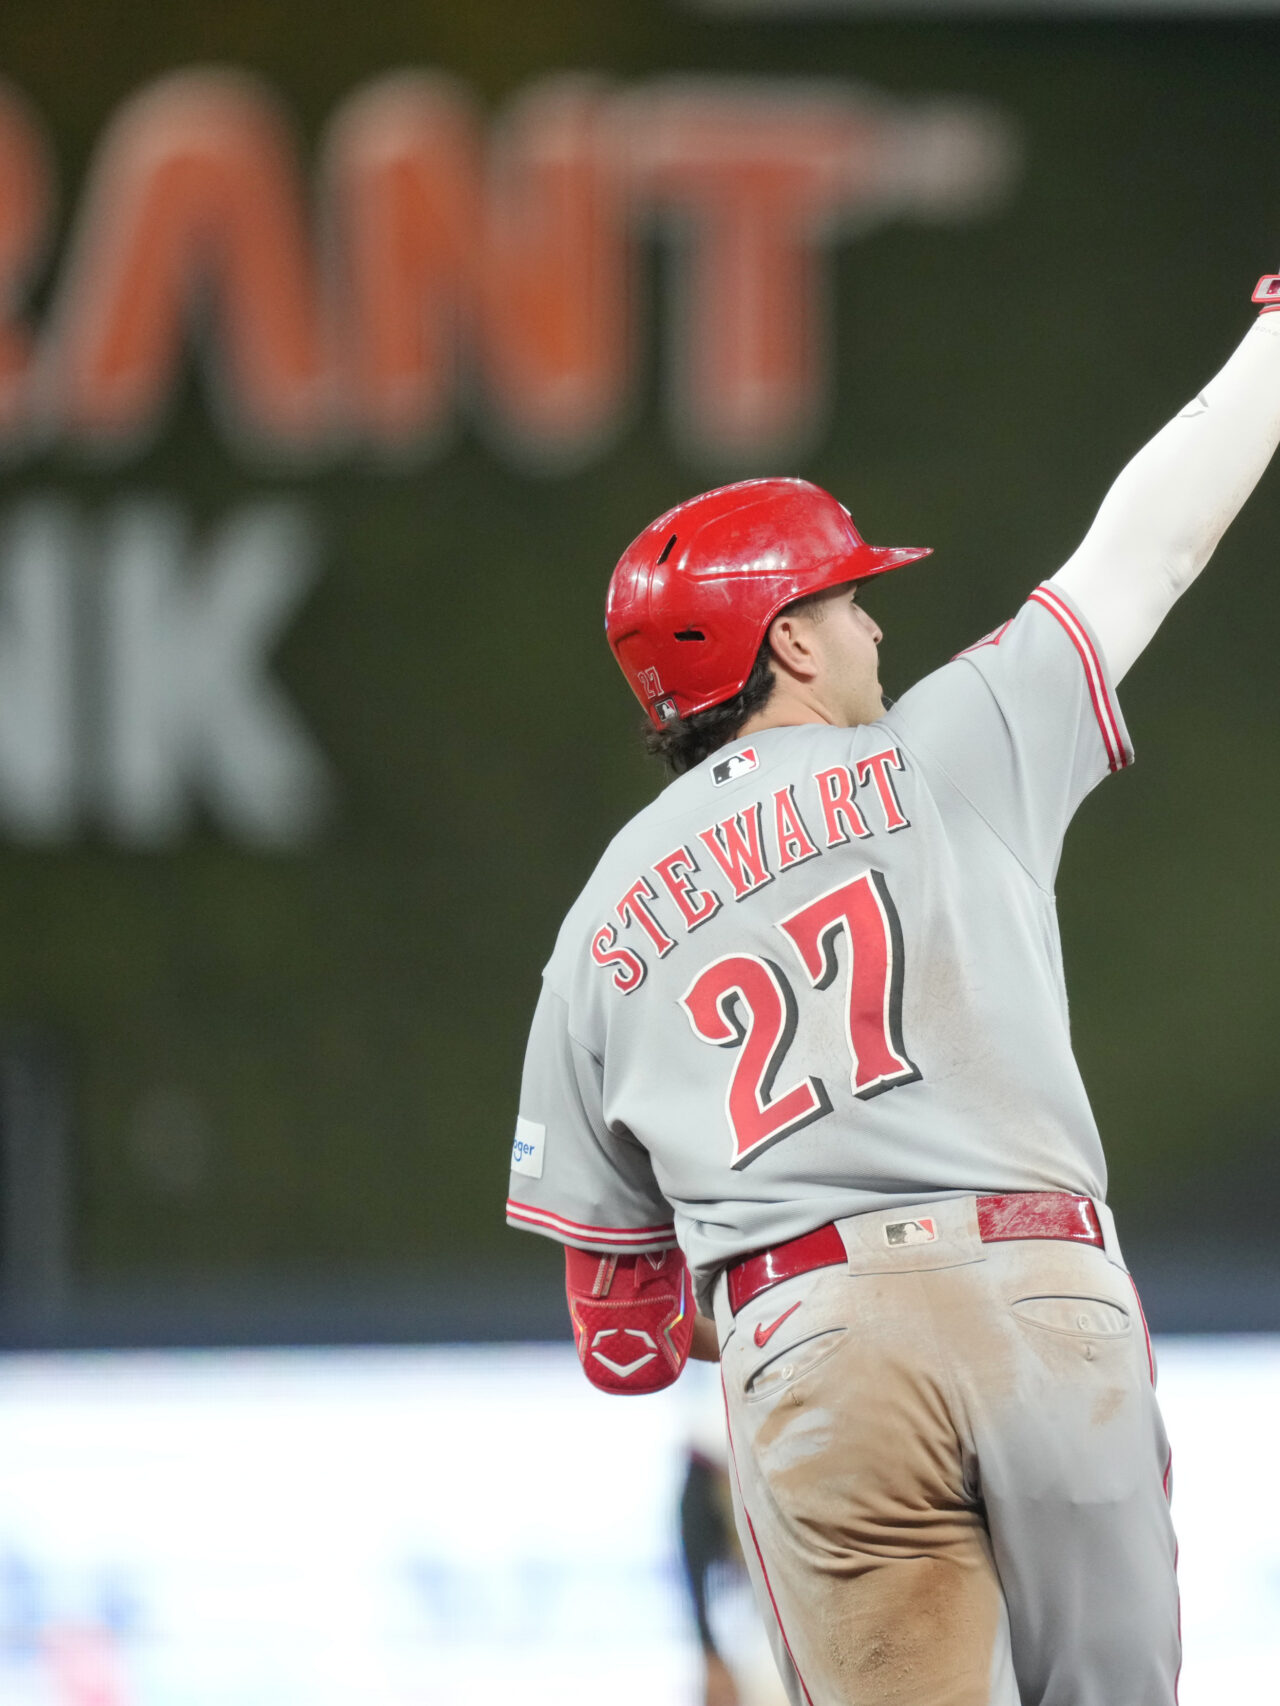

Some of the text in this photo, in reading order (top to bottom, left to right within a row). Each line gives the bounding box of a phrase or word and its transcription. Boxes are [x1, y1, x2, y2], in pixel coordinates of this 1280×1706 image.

[638, 666, 664, 699] 27
[591, 747, 911, 995] STEWART
[677, 868, 922, 1170] 27
[513, 1139, 535, 1162] oger
